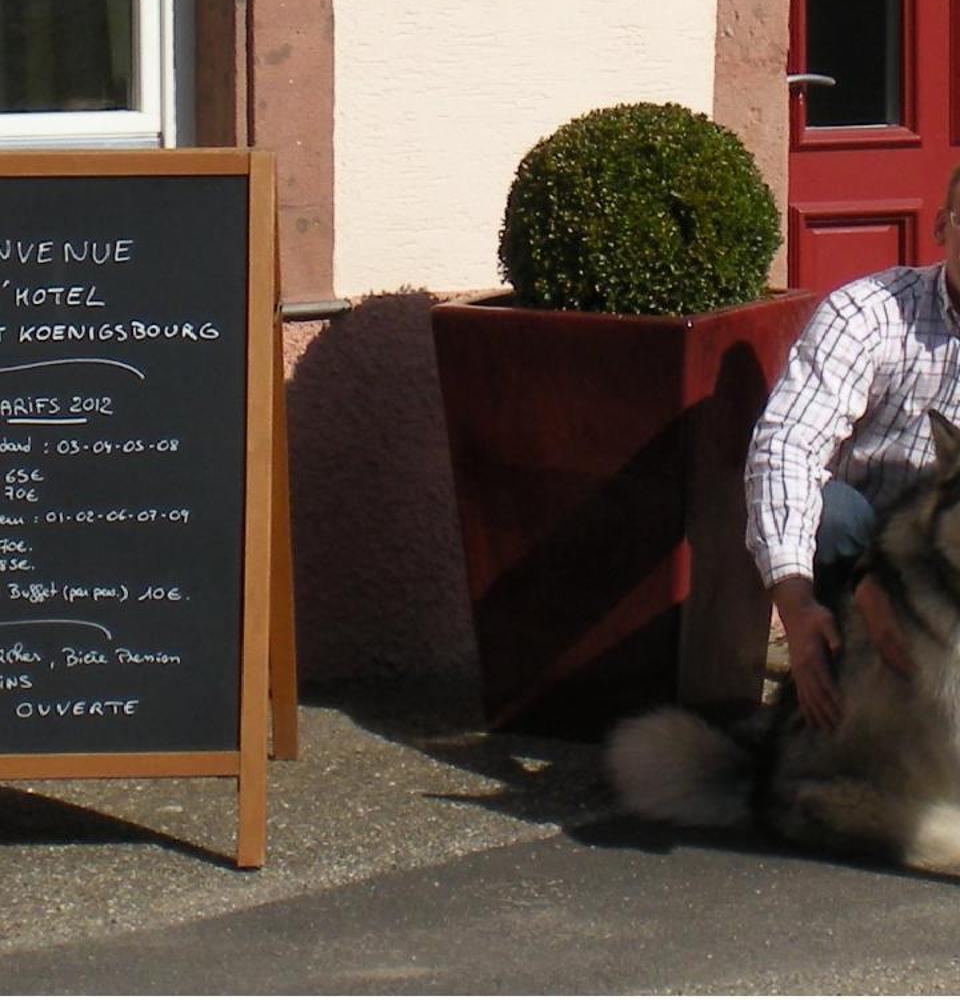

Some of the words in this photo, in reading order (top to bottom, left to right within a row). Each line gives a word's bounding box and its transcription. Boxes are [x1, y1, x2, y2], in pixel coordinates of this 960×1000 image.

[20, 321, 219, 342] KOENIGSBOURG
[70, 397, 113, 414] 2012
[6, 469, 44, 483] 65€
[5, 486, 38, 501] 70€
[8, 582, 58, 603] Buffet
[16, 700, 138, 717] OUVERTE
